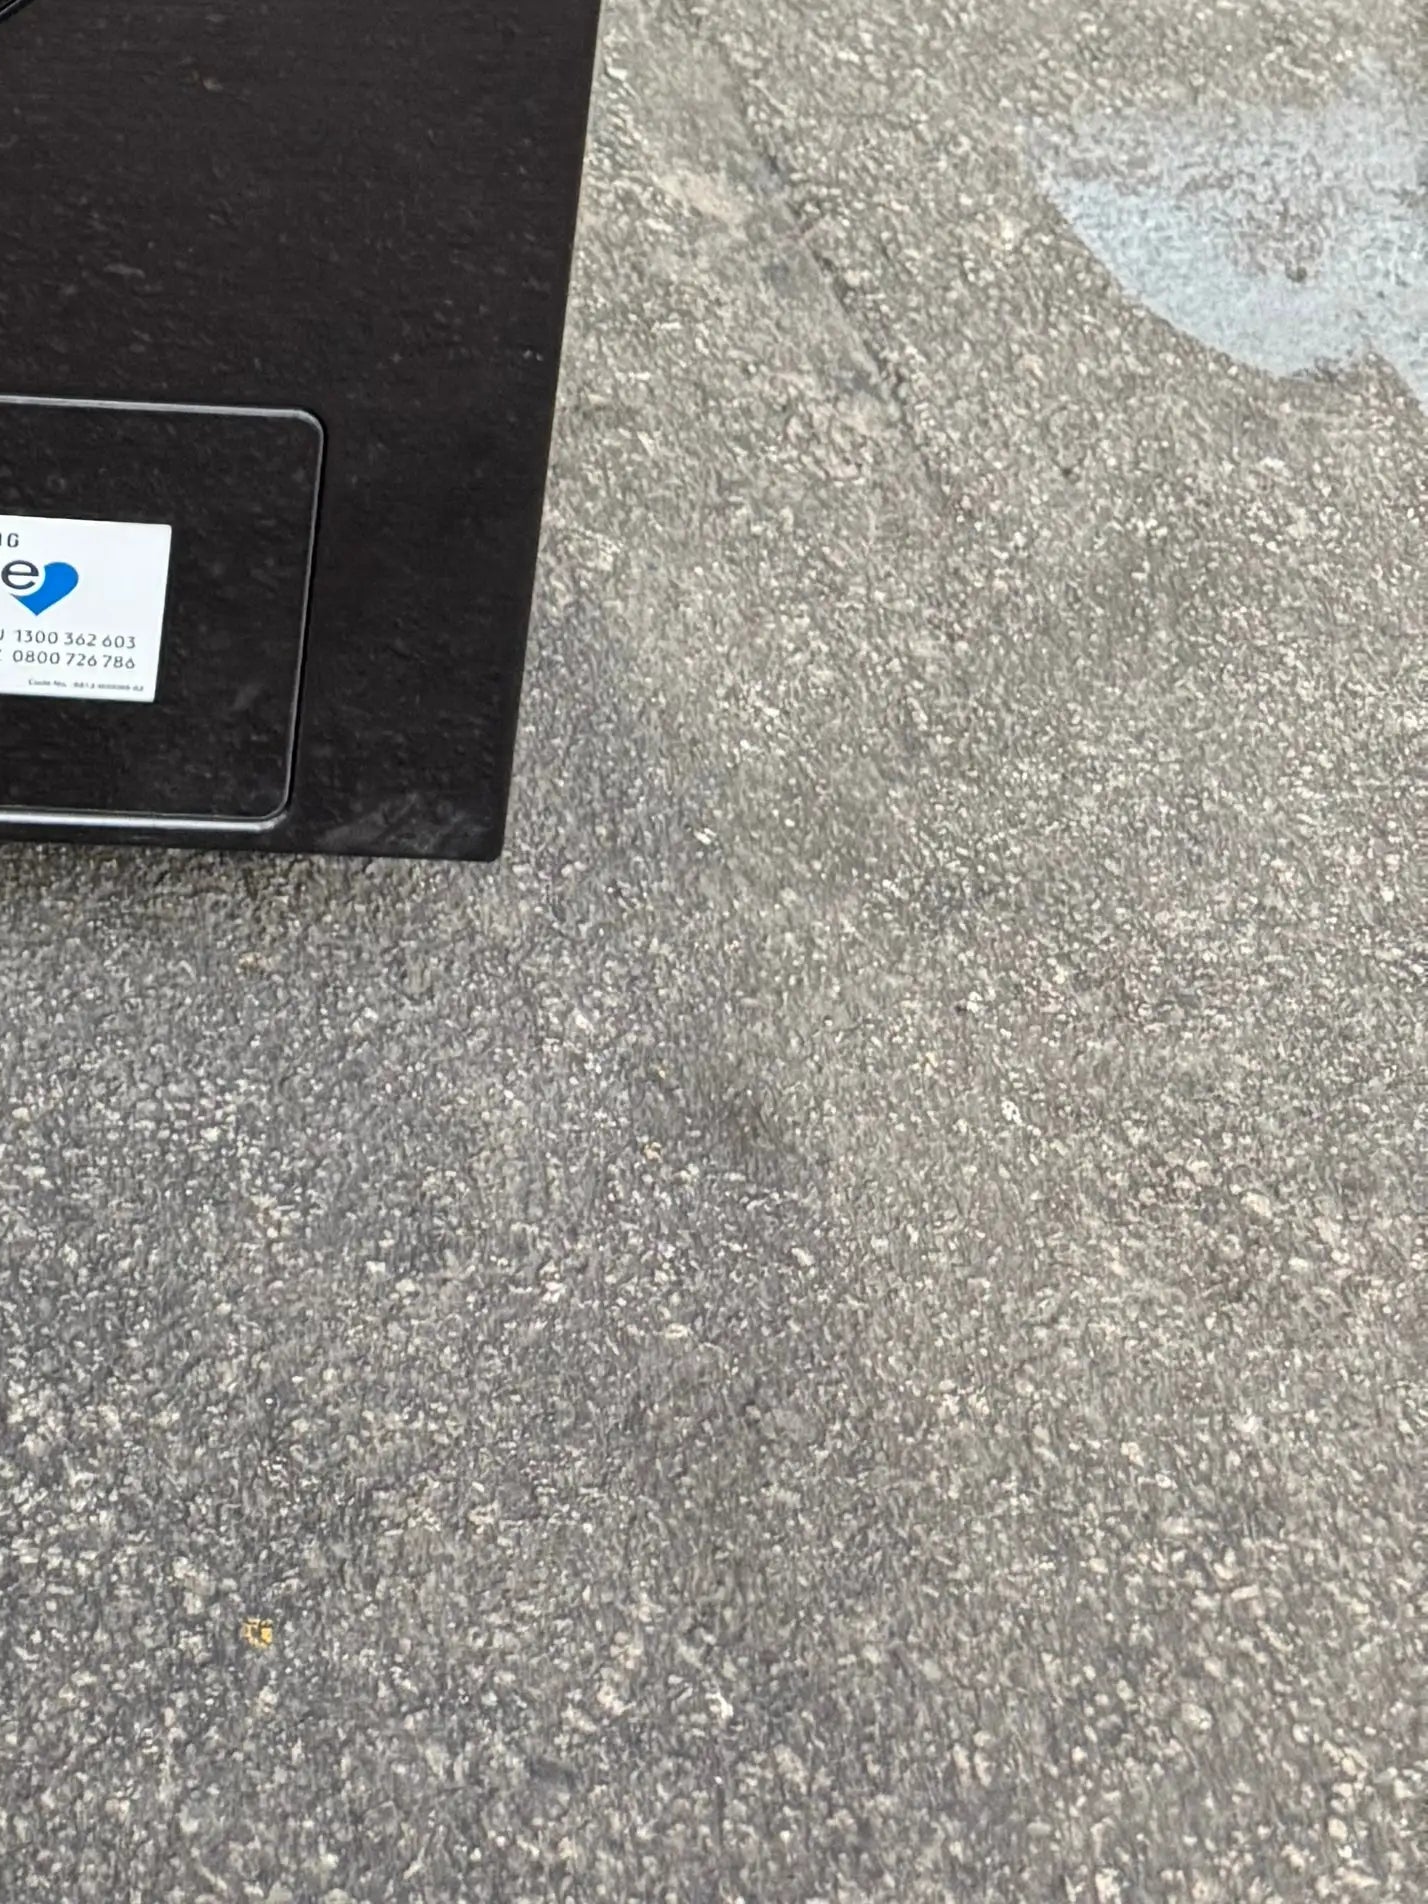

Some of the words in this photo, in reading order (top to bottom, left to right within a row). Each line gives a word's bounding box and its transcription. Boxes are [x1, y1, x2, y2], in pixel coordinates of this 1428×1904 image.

[16, 629, 59, 645] 1300
[64, 631, 98, 647] 362
[102, 634, 136, 649] 603
[12, 649, 60, 666] 0800
[65, 652, 97, 668] 726
[102, 654, 135, 669] 786
